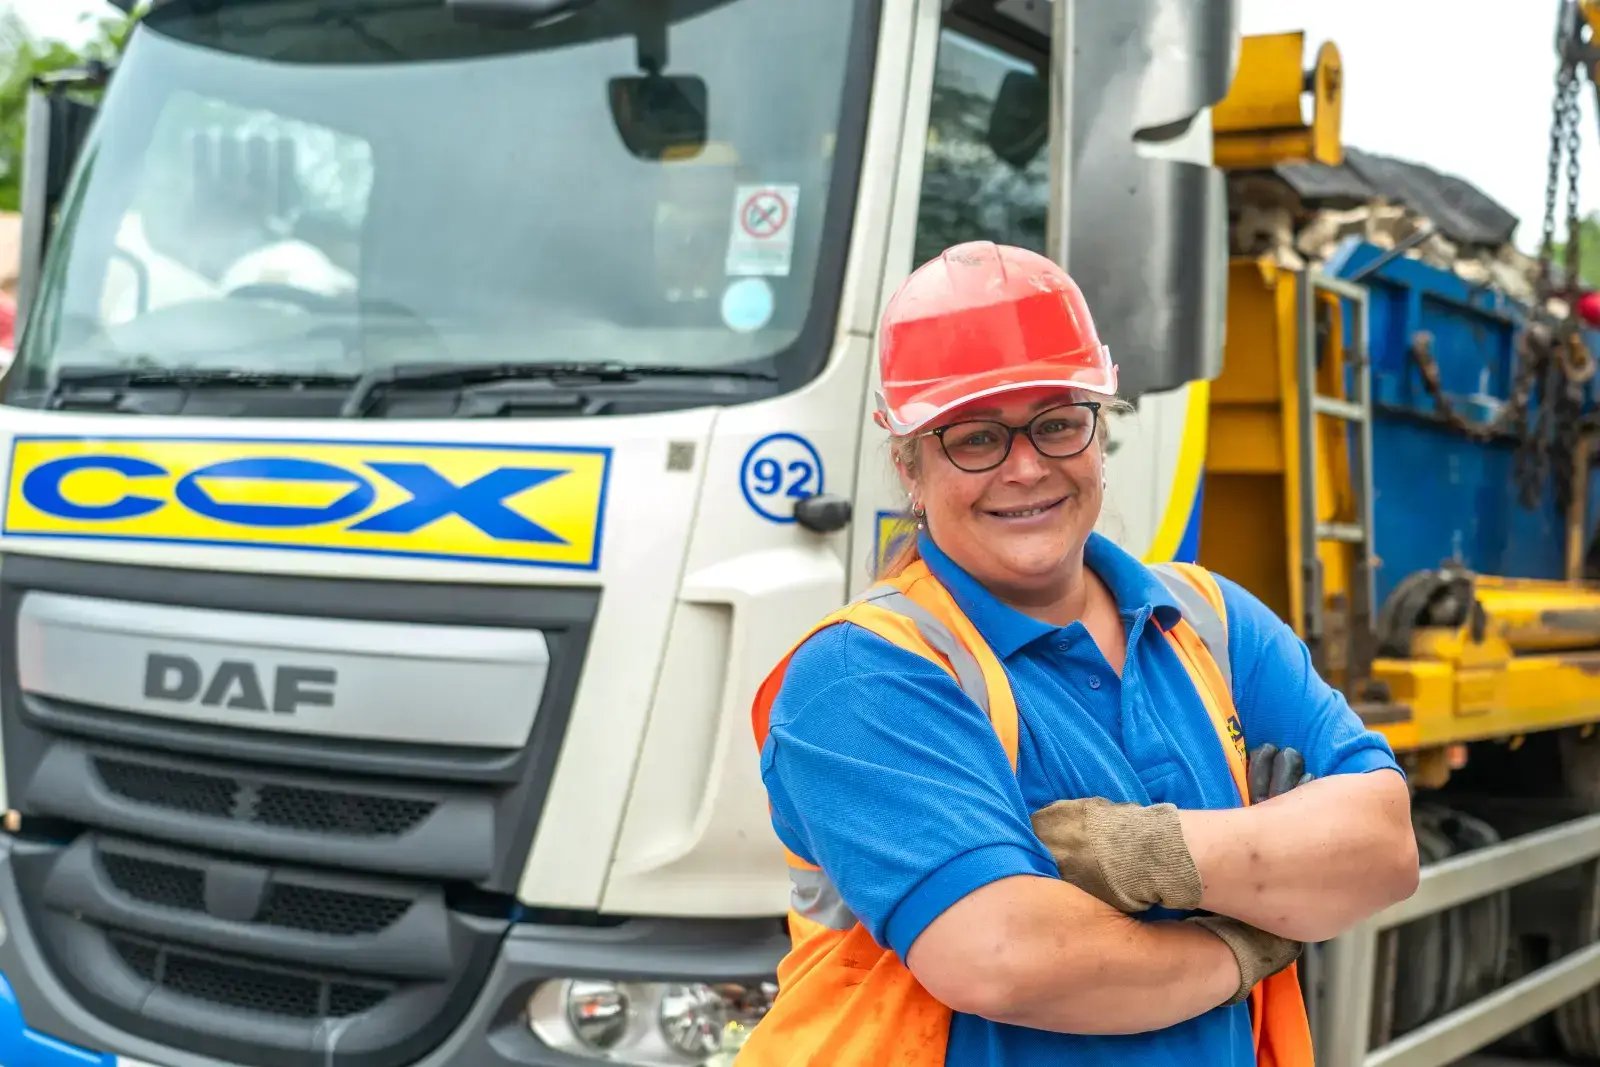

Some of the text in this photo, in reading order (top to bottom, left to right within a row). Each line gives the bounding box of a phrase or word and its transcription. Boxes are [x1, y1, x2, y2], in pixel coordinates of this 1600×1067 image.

[21, 453, 573, 546] COX
[752, 457, 814, 498] 92
[143, 652, 338, 715] DAF
